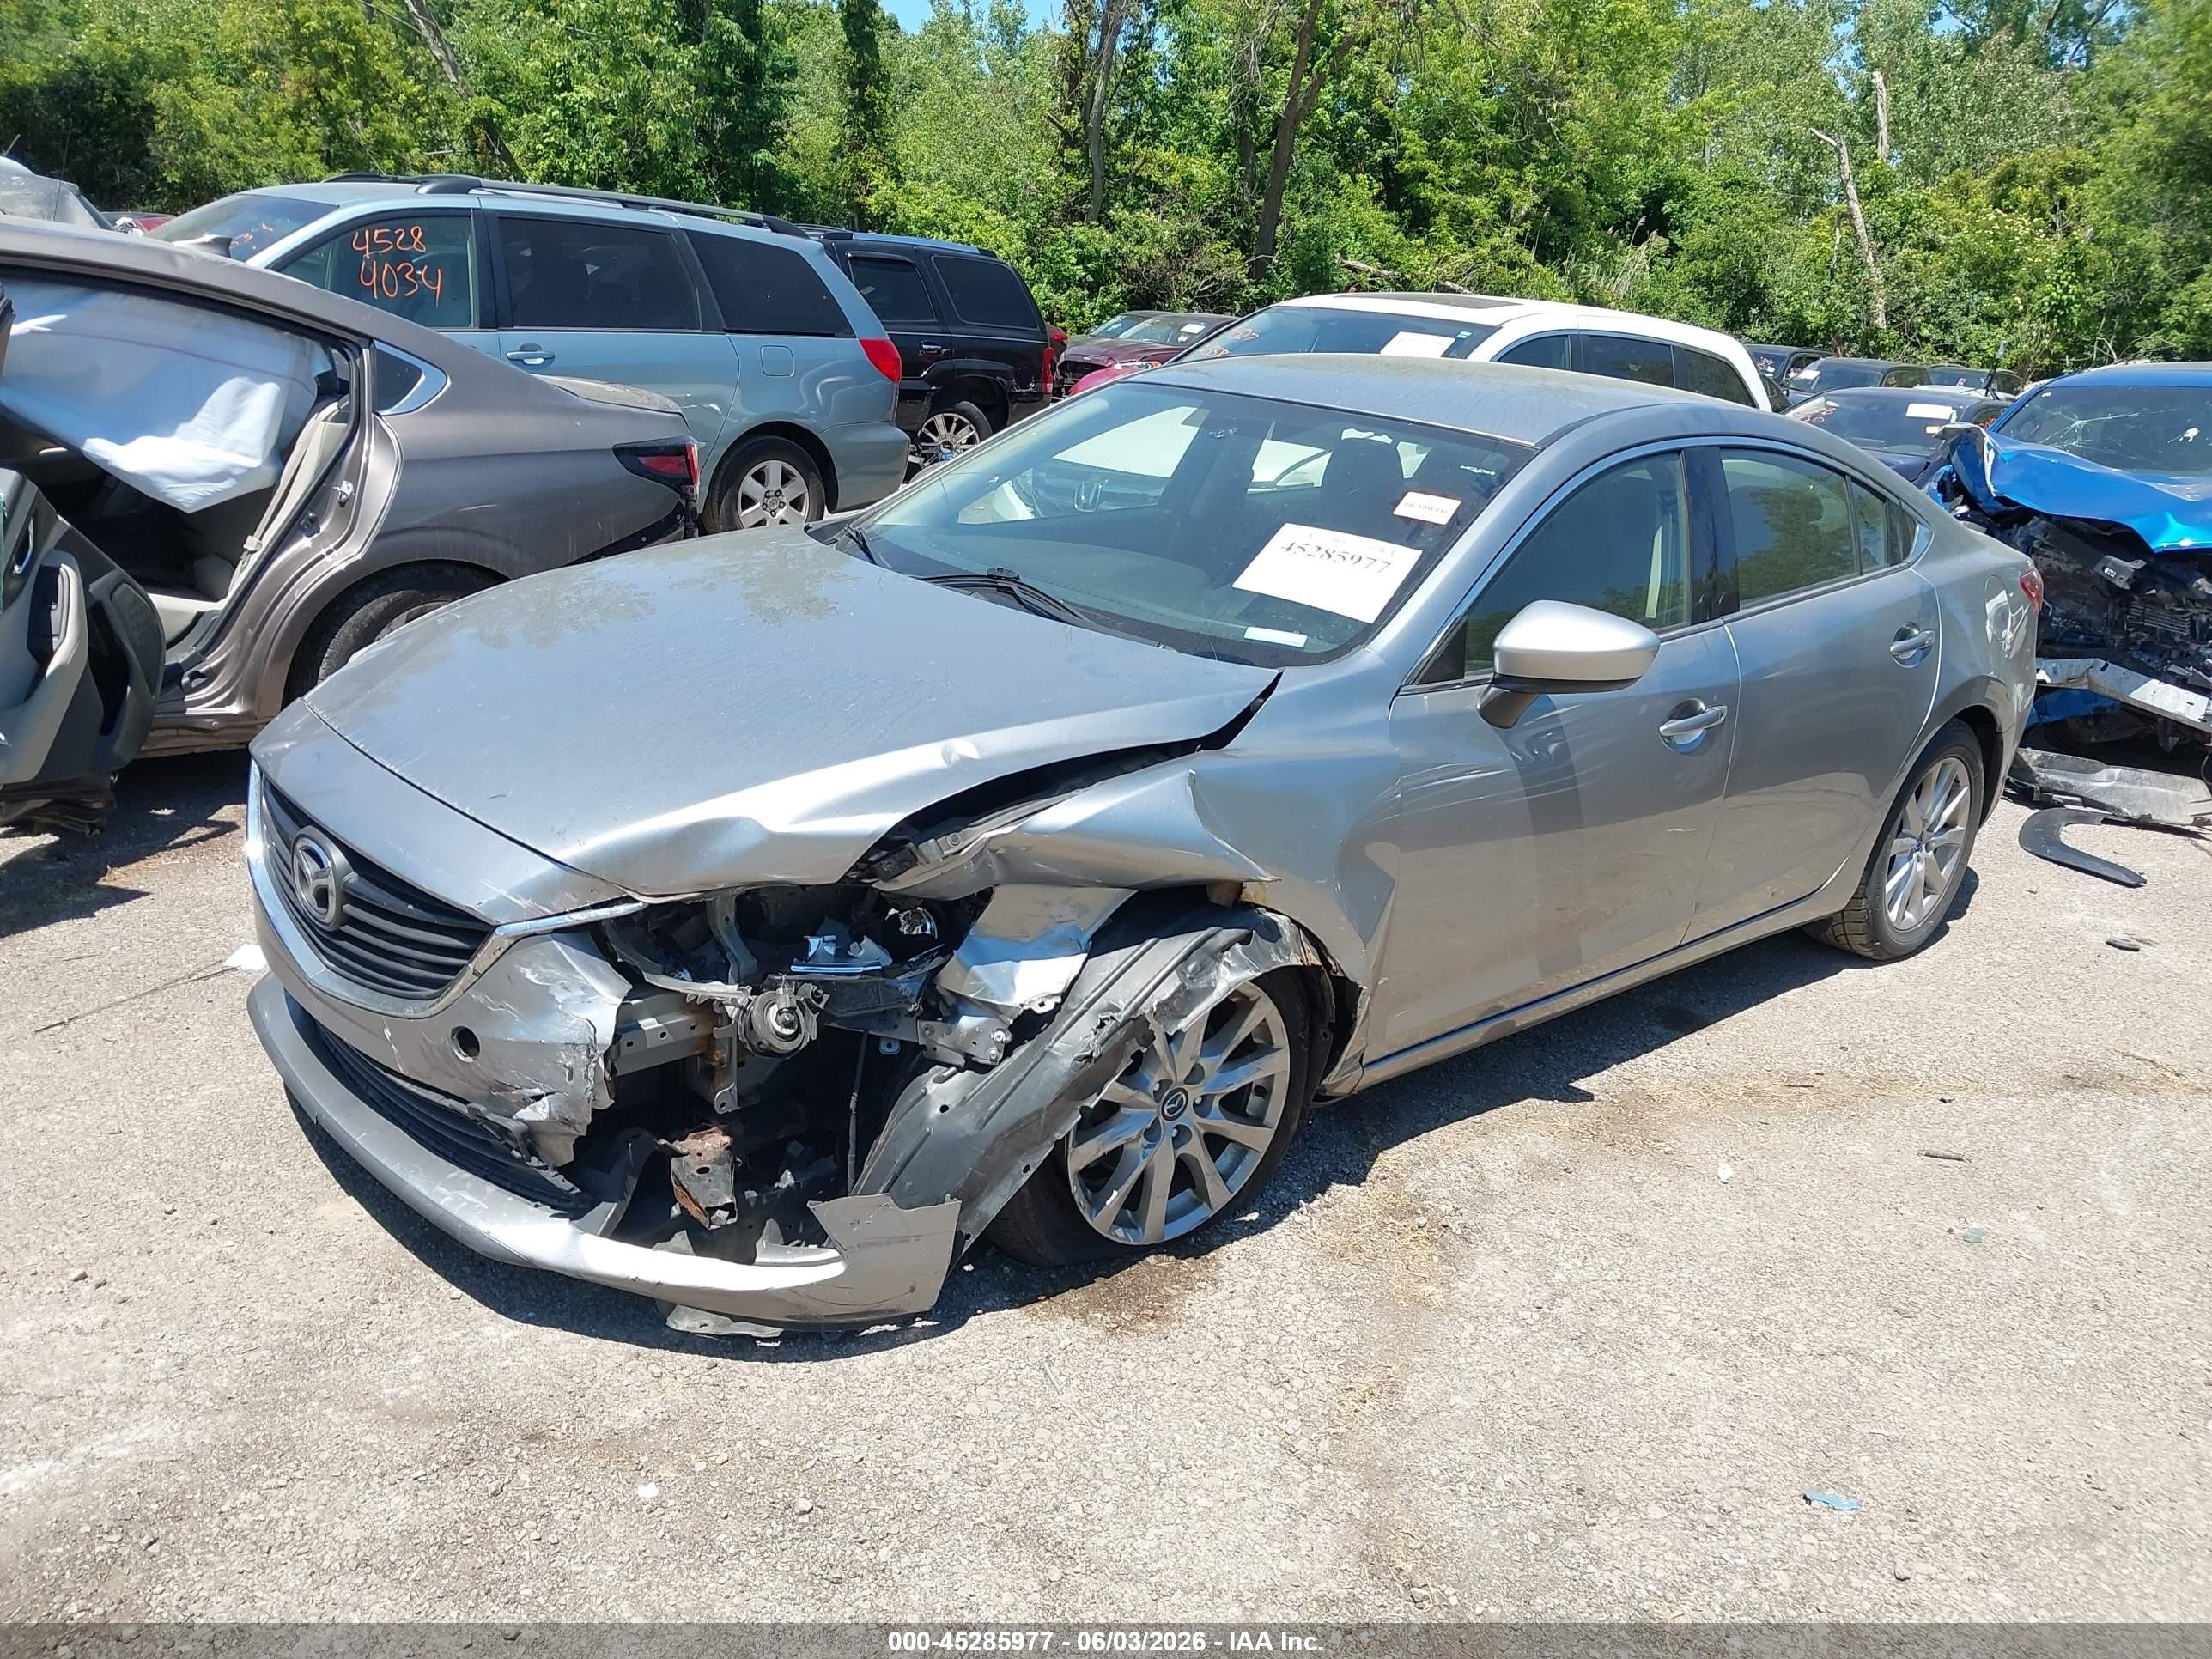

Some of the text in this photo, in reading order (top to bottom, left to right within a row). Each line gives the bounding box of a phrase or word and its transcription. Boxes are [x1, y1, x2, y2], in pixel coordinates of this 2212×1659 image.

[352, 226, 427, 258] 4528
[360, 260, 441, 307] 4034
[1280, 541, 1392, 574] 45285977
